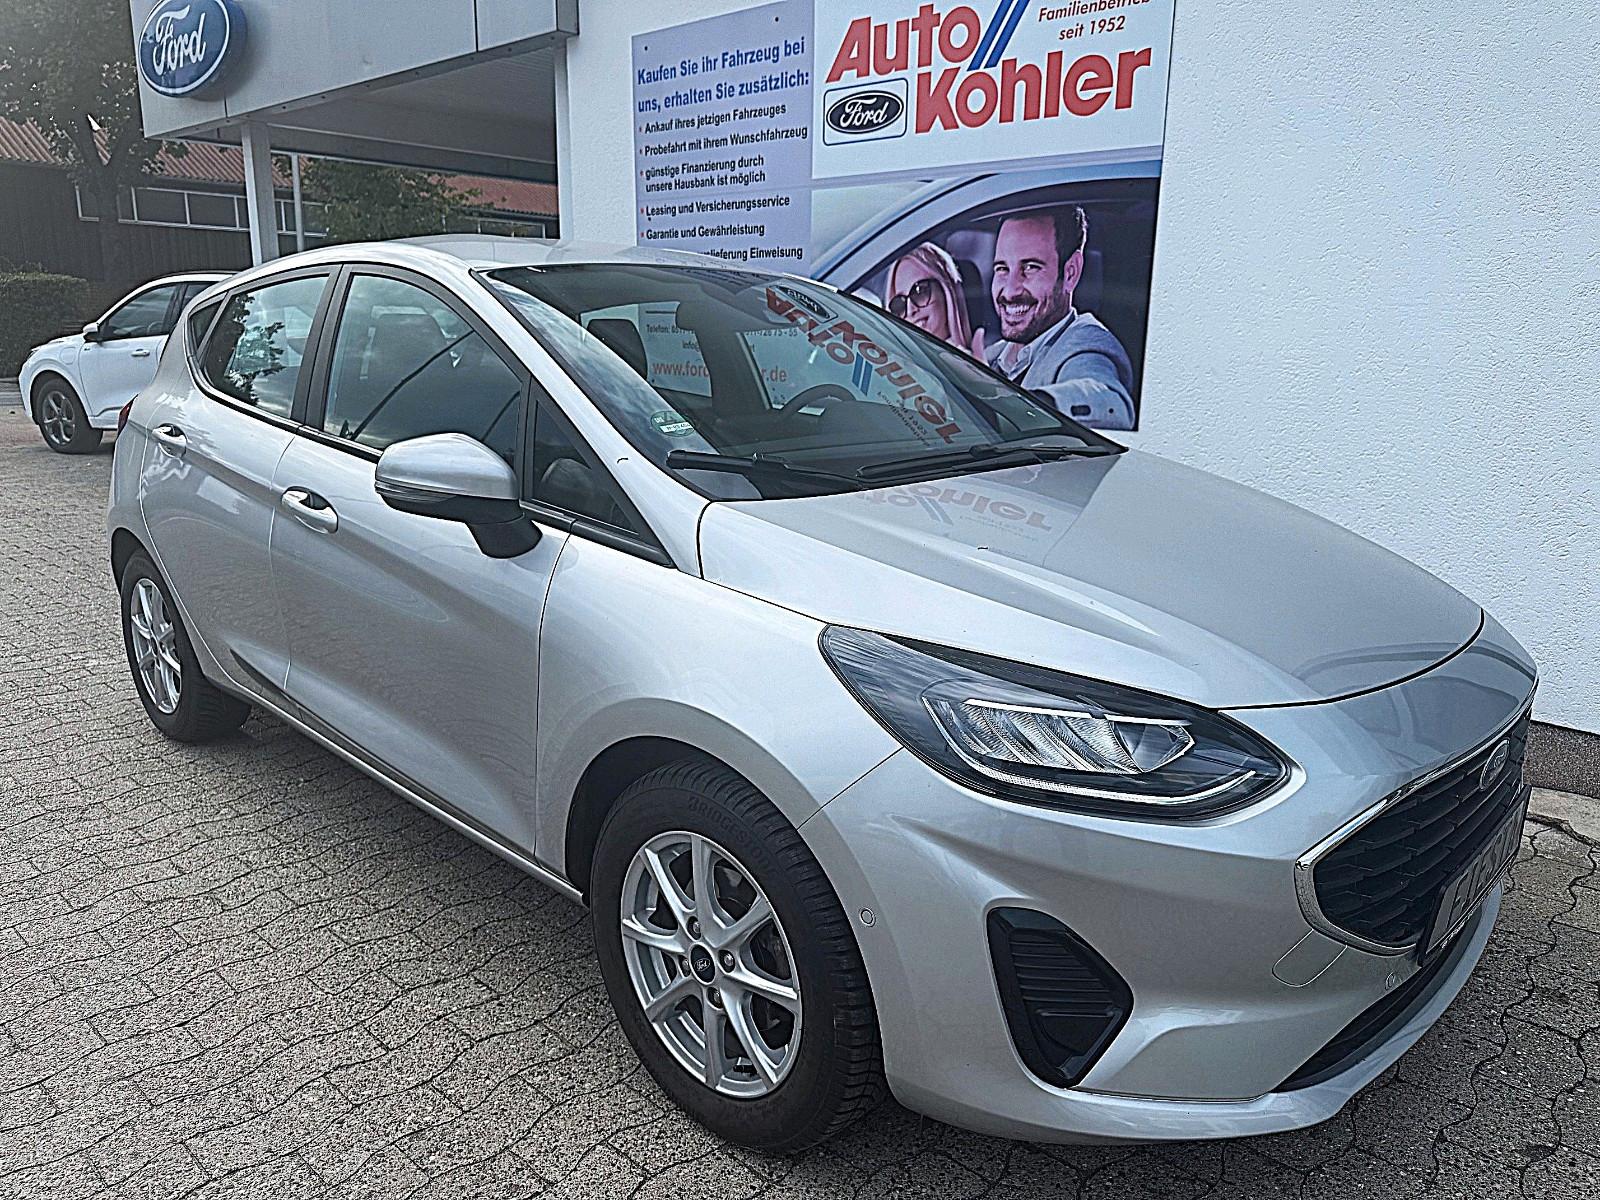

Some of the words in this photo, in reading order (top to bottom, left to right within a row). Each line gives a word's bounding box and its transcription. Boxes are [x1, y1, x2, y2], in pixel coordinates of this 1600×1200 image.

[1038, 0, 1151, 22] Familienbetr
[153, 4, 206, 76] Ford
[1058, 22, 1085, 40] seit
[1090, 15, 1126, 35] 1952
[826, 3, 981, 83] Auto
[637, 64, 677, 86] Kaufen
[680, 59, 698, 77] Sie
[702, 56, 718, 73] ihr
[721, 45, 780, 69] Fahrzeug
[784, 36, 805, 57] bei
[638, 98, 661, 113] uns,
[664, 88, 712, 108] erhalten
[716, 82, 735, 99] Sie
[738, 69, 809, 96] zusätzlich:
[645, 119, 674, 134] Ankauf
[675, 116, 696, 130] ihres
[696, 110, 731, 131] jetzigen
[733, 103, 787, 121] Fahrzeuges
[840, 97, 890, 128] Ford
[644, 144, 687, 156] Probefahrt
[688, 140, 702, 150] mit
[703, 137, 728, 149] ihrem
[730, 126, 808, 146] Wunschfahrzeug
[645, 165, 680, 181] günstige
[681, 159, 736, 175] Finanzierung
[737, 154, 764, 168] durch
[646, 182, 672, 193] unsere
[674, 176, 715, 190] Hausbank
[717, 174, 728, 185] ist
[729, 170, 766, 184] möglich
[645, 205, 677, 217] Leasing
[678, 202, 694, 214] und
[695, 195, 790, 212] Versicherungsservice
[646, 229, 679, 240] Garantie
[681, 226, 696, 238] und
[698, 223, 765, 238] Gewährleistung
[750, 246, 803, 260] Einweisung
